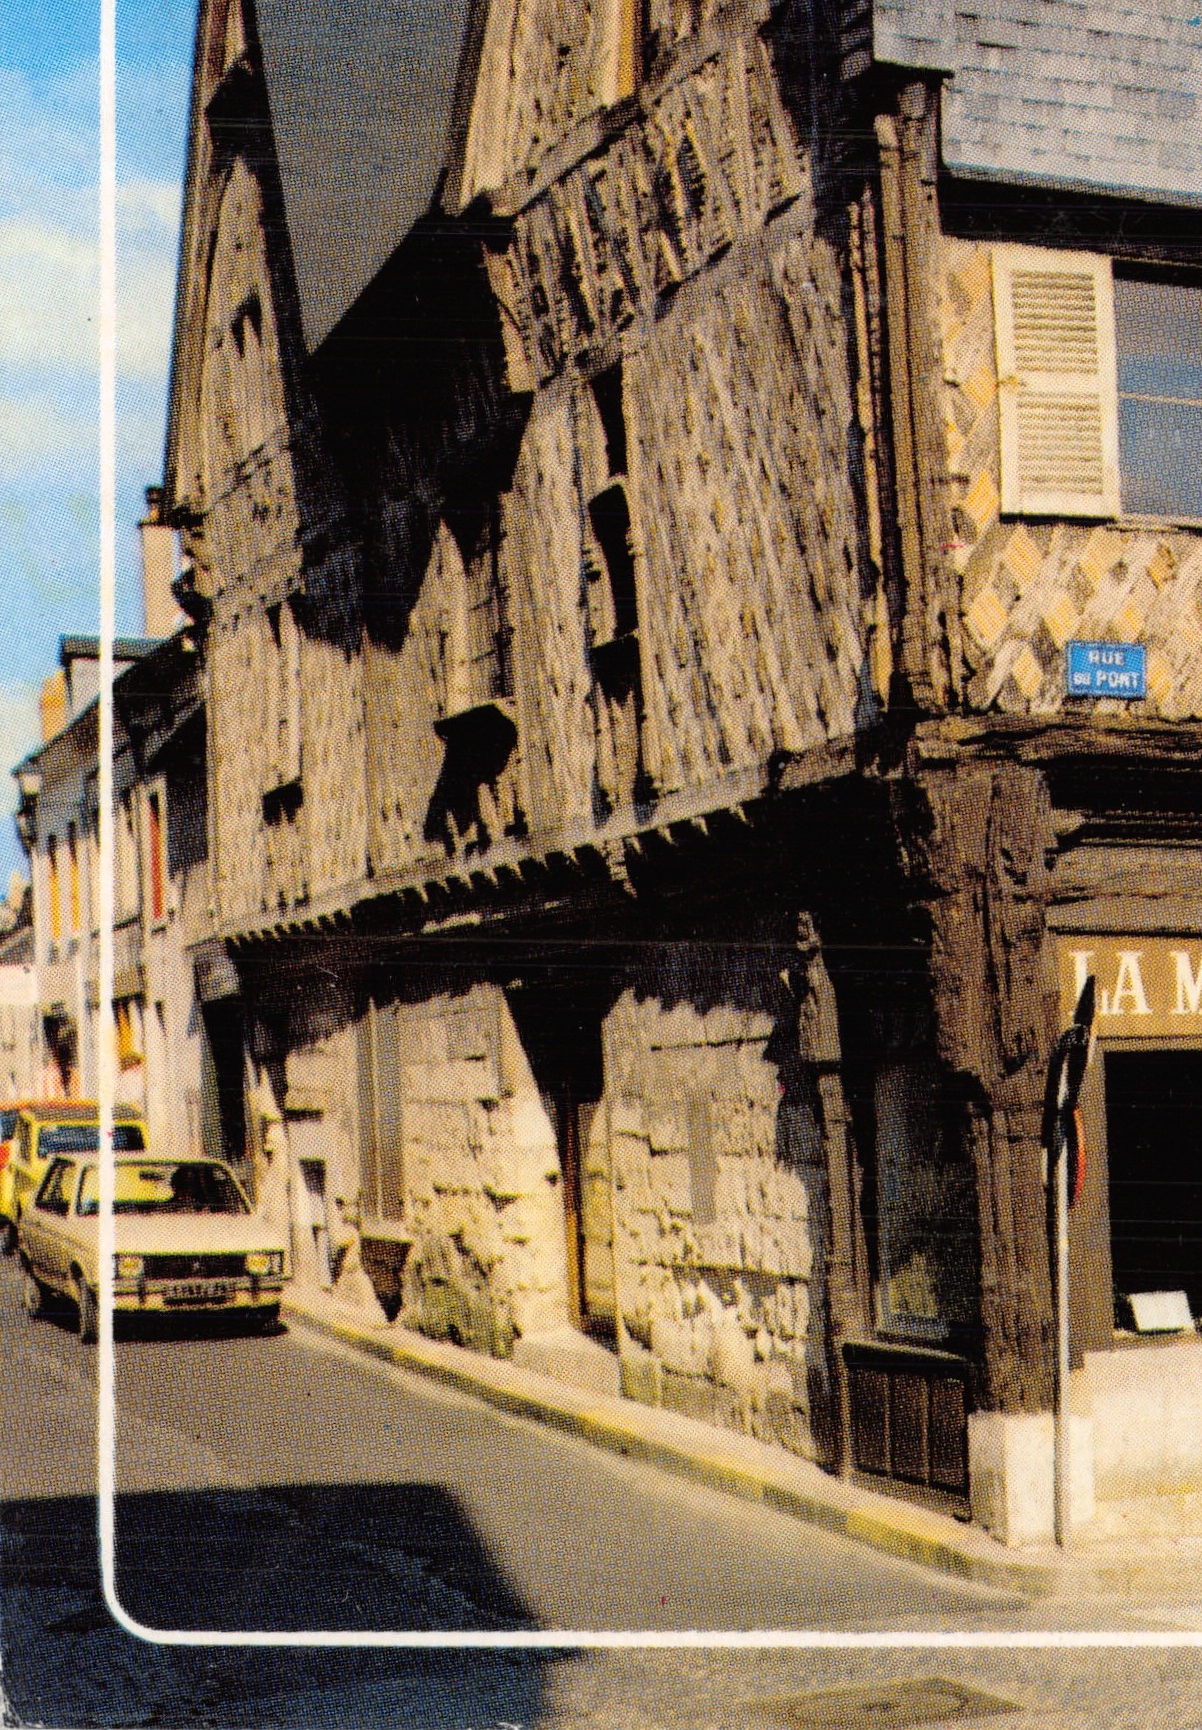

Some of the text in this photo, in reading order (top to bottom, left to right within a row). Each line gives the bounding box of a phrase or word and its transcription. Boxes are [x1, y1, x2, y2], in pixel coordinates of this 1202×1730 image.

[1088, 650, 1125, 666] RUE
[1096, 670, 1140, 688] PONT
[1069, 950, 1152, 1015] LA
